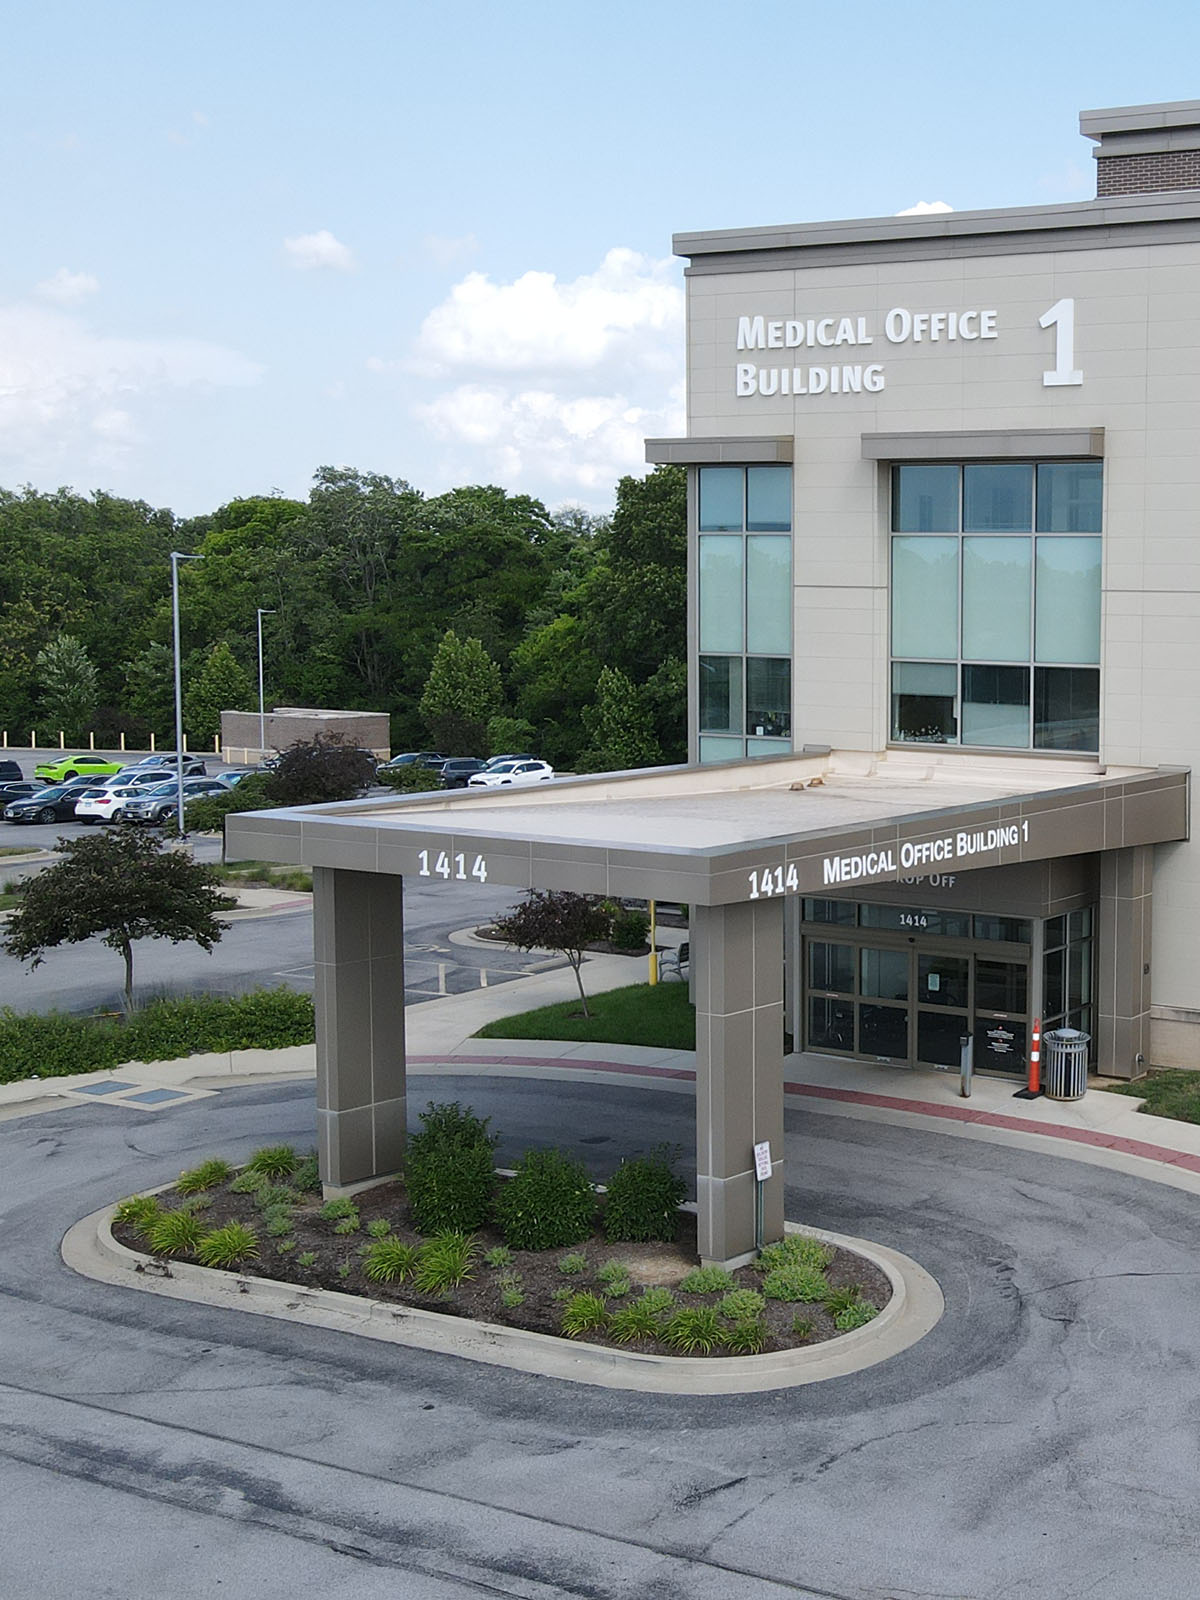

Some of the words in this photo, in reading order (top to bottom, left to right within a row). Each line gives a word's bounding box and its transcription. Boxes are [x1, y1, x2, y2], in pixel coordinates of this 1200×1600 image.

[736, 315, 874, 350] MEDICAL
[884, 307, 999, 344] OFFICE
[1038, 298, 1084, 387] 1
[736, 363, 886, 397] BUILDING
[418, 849, 488, 883] 1414
[749, 863, 799, 899] 1414
[823, 850, 896, 884] MEDICAL
[901, 837, 953, 869] OFFICE
[957, 828, 1018, 857] BUILDING
[1022, 820, 1029, 843] 1
[929, 873, 956, 888] OFF
[899, 913, 928, 928] 1414
